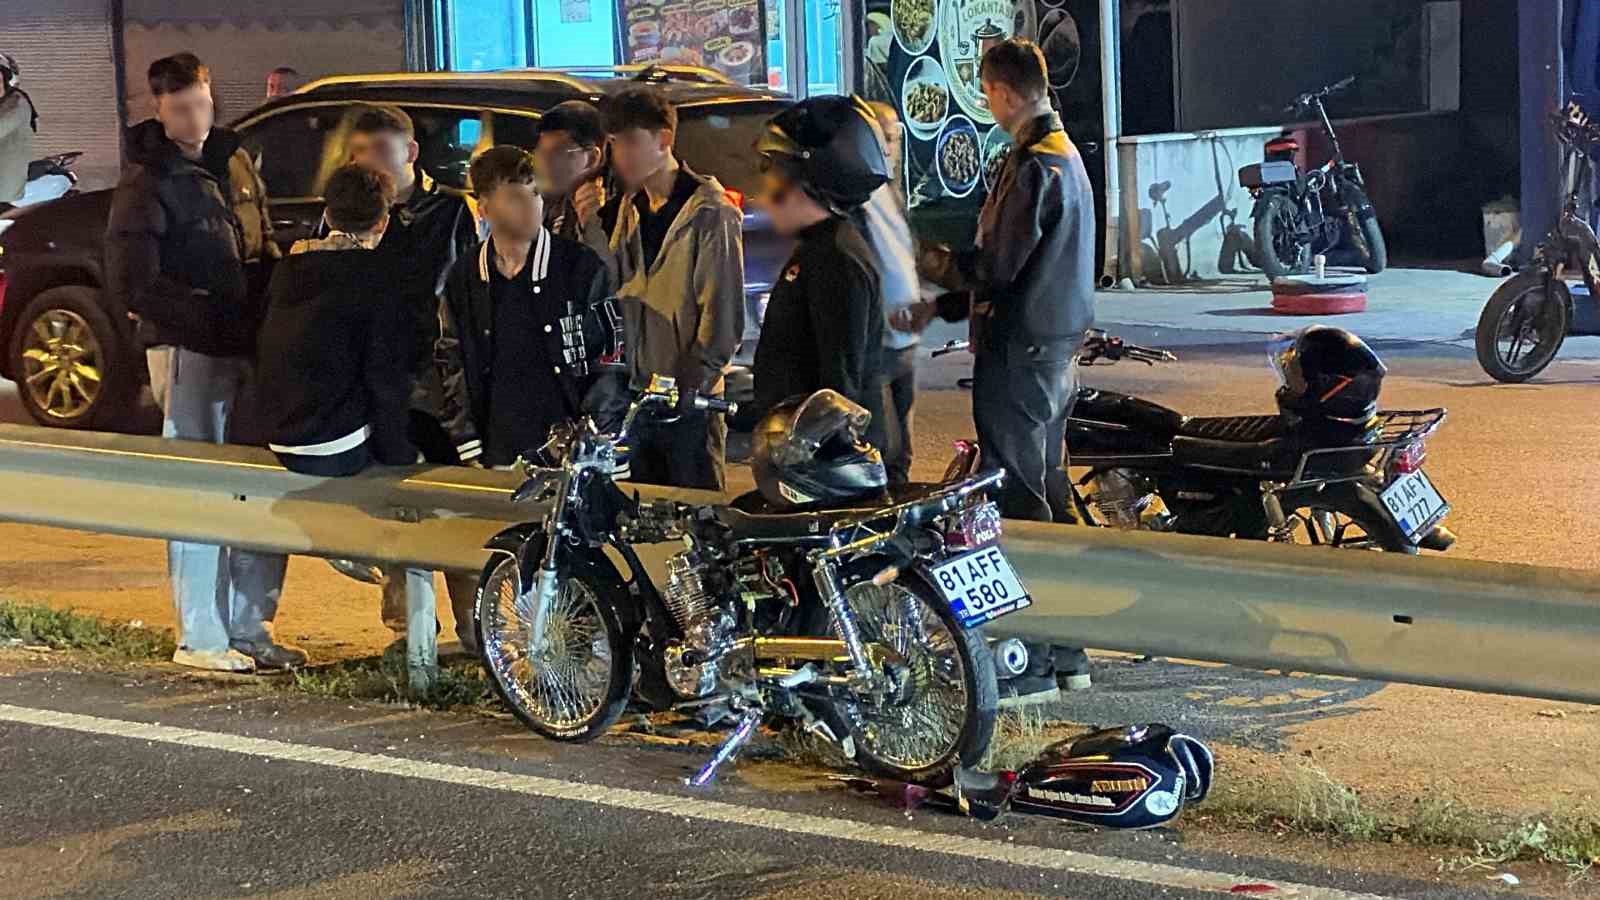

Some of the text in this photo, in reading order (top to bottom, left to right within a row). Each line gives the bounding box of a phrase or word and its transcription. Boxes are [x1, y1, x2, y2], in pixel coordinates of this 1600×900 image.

[1387, 472, 1426, 513] 81 AFY
[1408, 497, 1431, 525] 777
[939, 550, 1001, 591] 81 AFF
[966, 579, 1008, 609] 580
